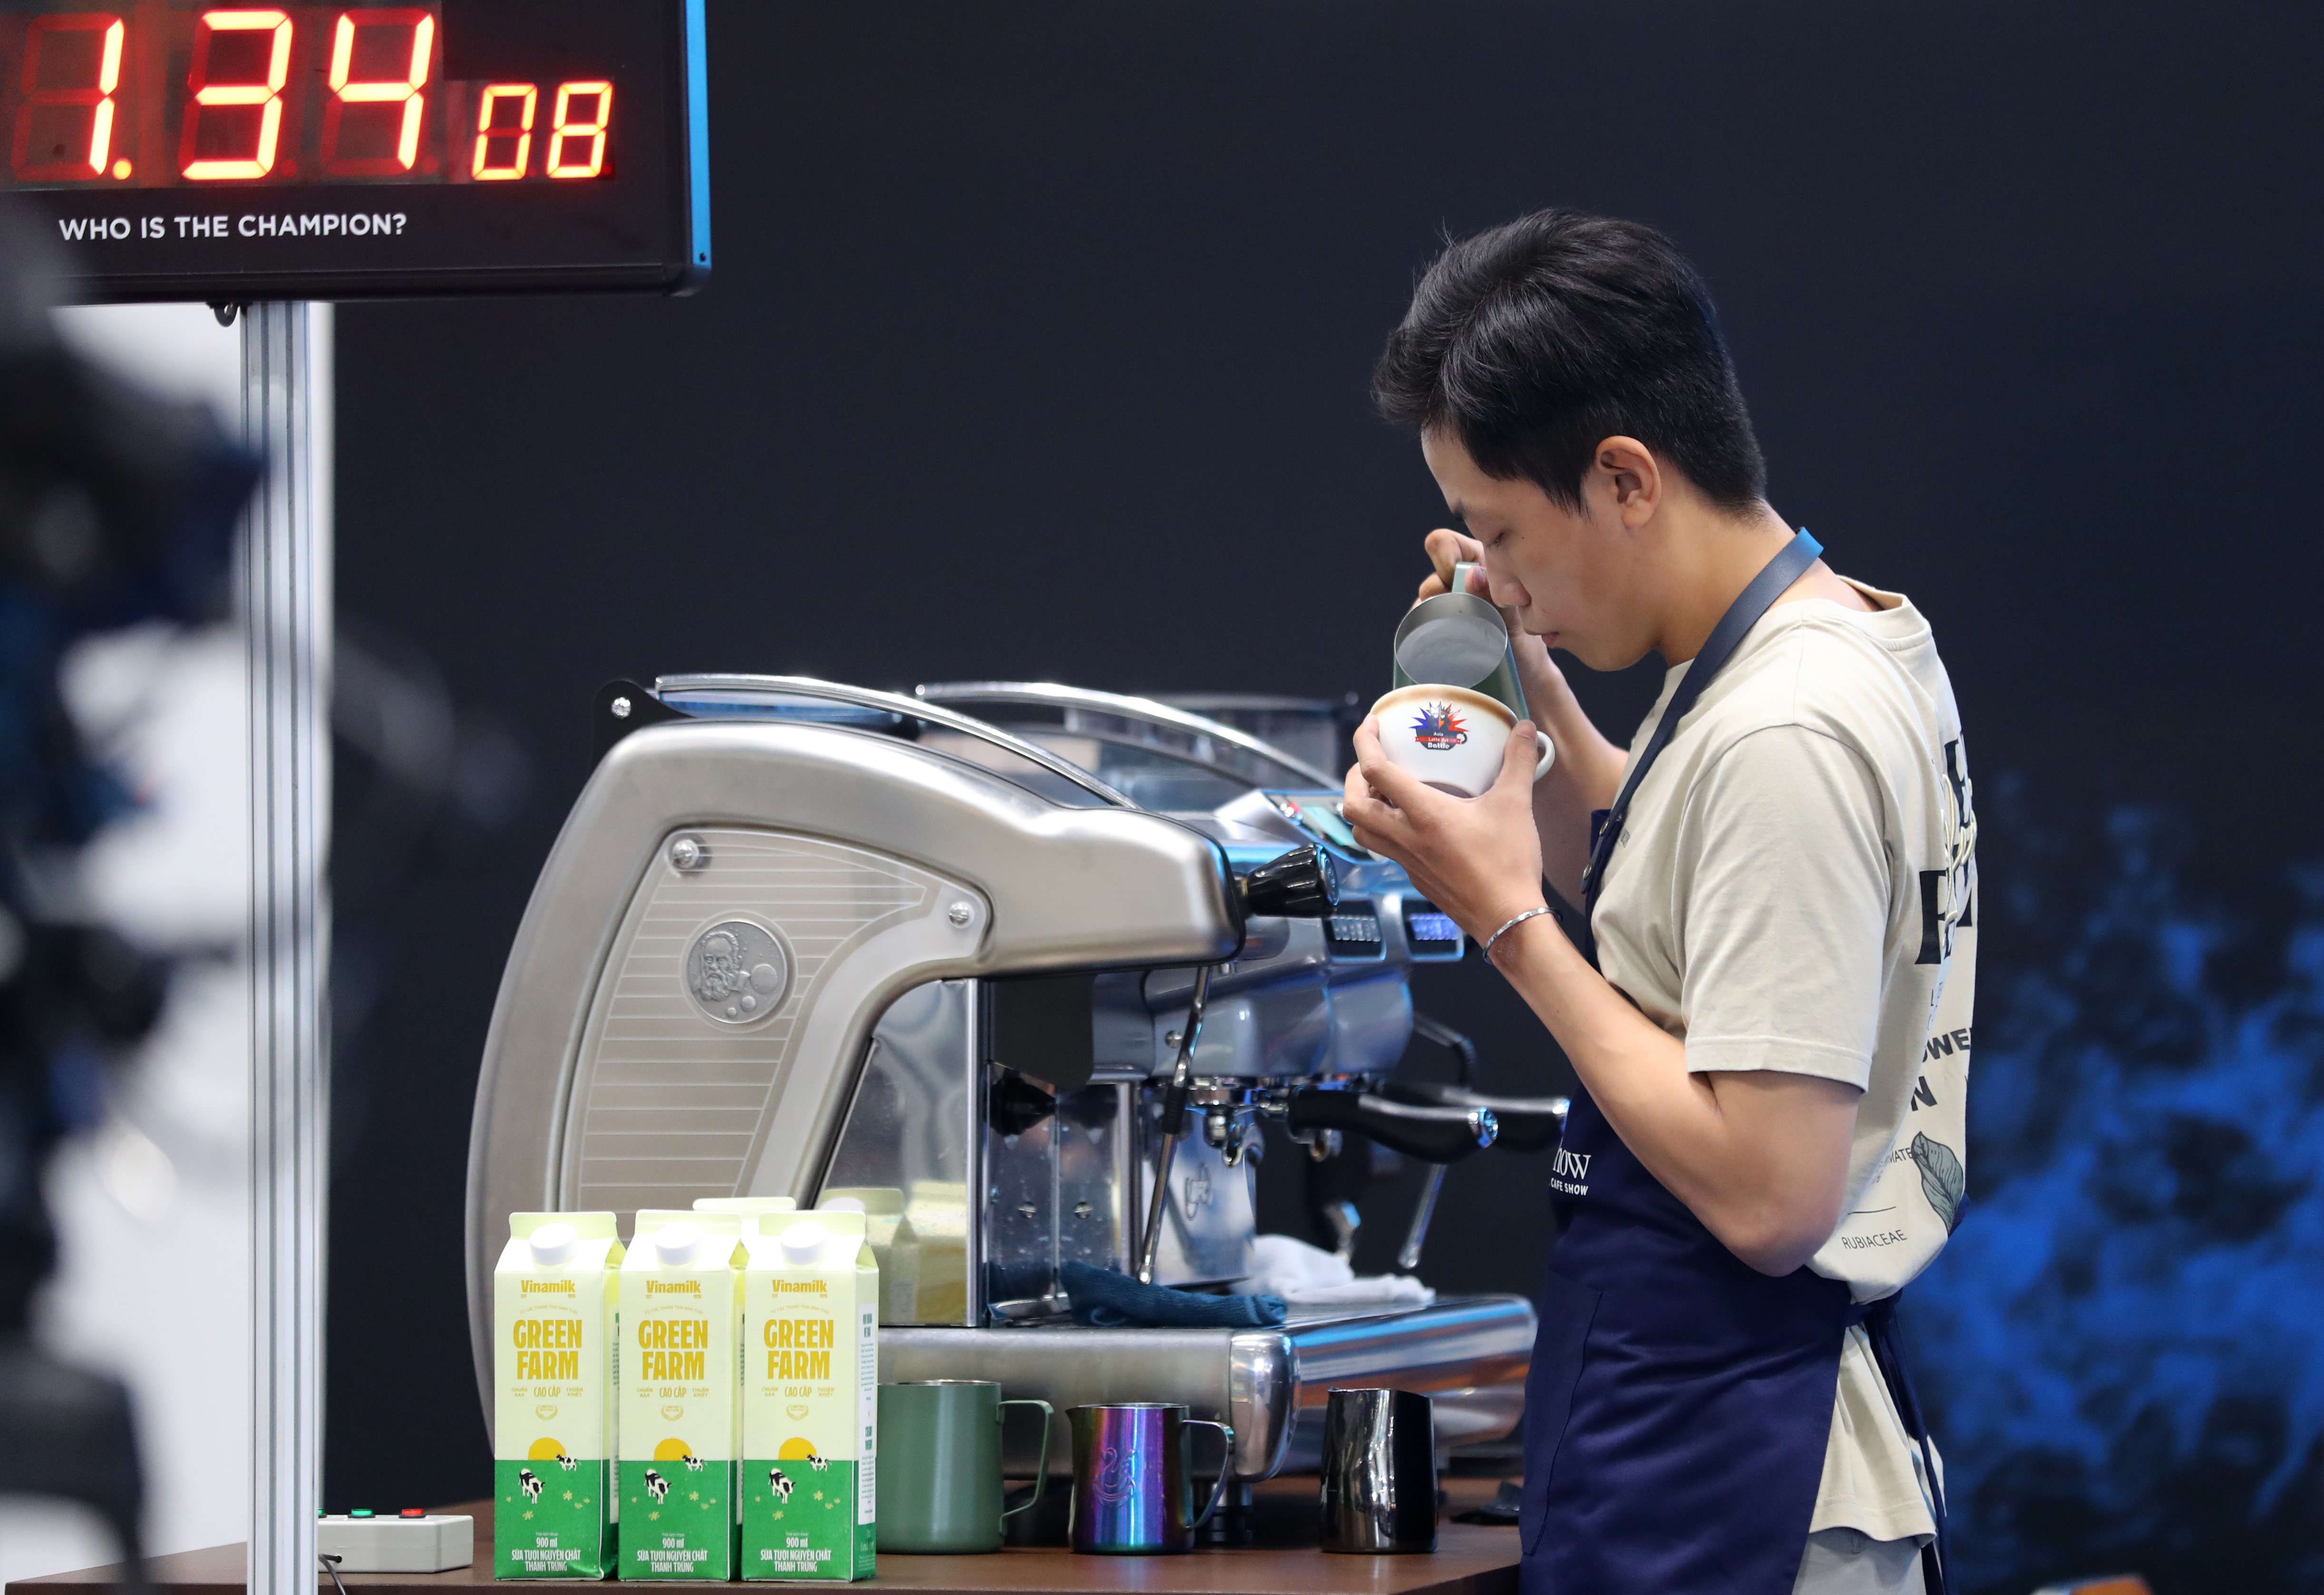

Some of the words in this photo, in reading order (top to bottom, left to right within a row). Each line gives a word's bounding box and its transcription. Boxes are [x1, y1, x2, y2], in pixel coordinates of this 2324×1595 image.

[471, 81, 613, 180] 08
[59, 218, 131, 241] WHO
[141, 217, 165, 239] IS
[174, 216, 229, 238] THE
[238, 214, 407, 237] CHAMPION?
[1551, 1177, 1563, 1191] CAFE
[1565, 1183, 1589, 1196] SHOW
[1842, 1229, 1907, 1249] RUBIACEAE
[521, 1280, 575, 1293] Vinamilk
[646, 1280, 700, 1293] Vinamilk
[772, 1280, 827, 1293] Vinamilk
[513, 1320, 582, 1349] GREEN
[638, 1320, 708, 1349] GREEN
[764, 1319, 834, 1349] GREEN
[517, 1351, 578, 1380] FARM
[642, 1352, 704, 1380] FARM
[768, 1351, 830, 1380] FARM
[534, 1387, 546, 1397] CAO
[659, 1387, 672, 1398] CAO
[785, 1387, 797, 1397] CAO
[536, 1537, 548, 1547] 900
[550, 1537, 557, 1547] ml
[662, 1538, 675, 1548] 900
[676, 1538, 684, 1548] ml
[786, 1537, 799, 1547] 900
[800, 1537, 807, 1547] ml
[525, 1561, 546, 1571] THANH
[651, 1562, 672, 1572] THANH
[774, 1561, 795, 1572] THANH
